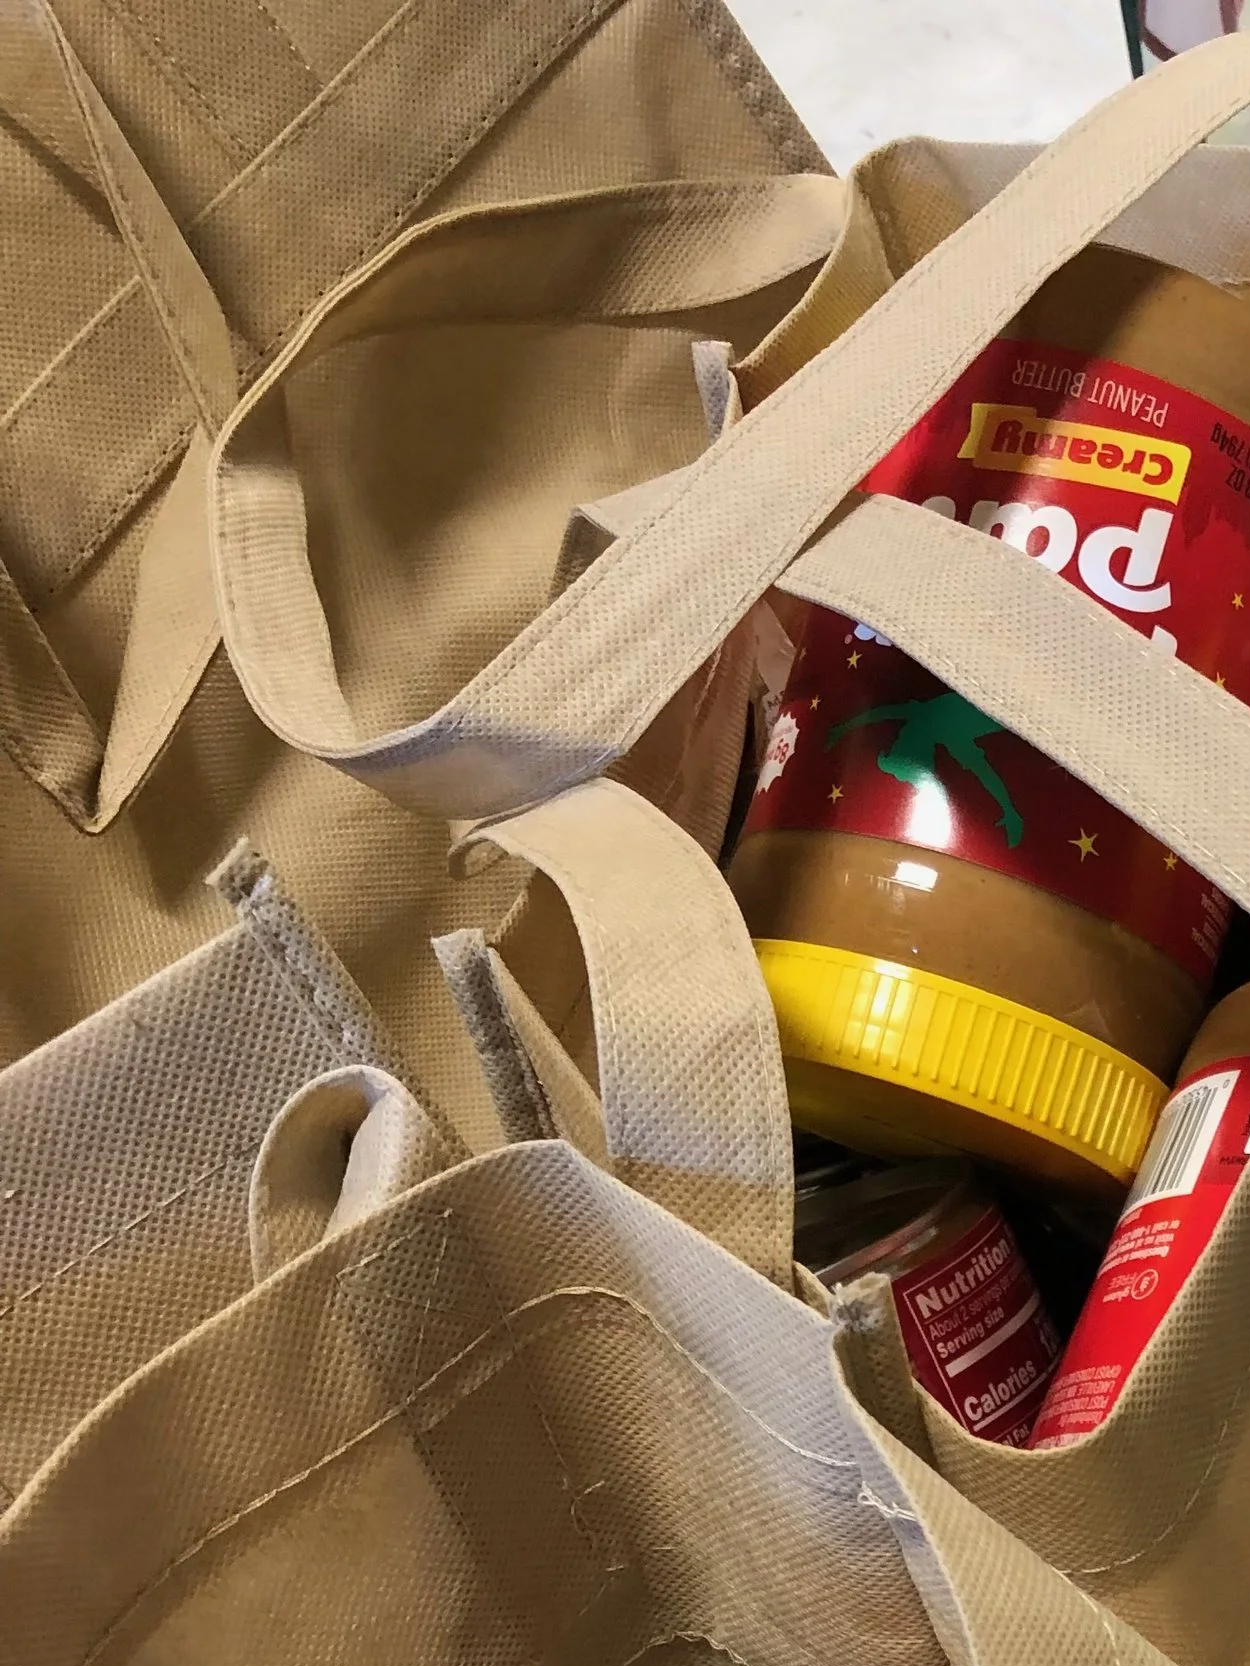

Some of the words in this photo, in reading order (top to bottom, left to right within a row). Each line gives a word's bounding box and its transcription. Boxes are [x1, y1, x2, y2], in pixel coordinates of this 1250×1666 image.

[1012, 360, 1086, 397] BUTTER
[1088, 378, 1168, 427] PEANUT
[991, 416, 1176, 488] Creamy
[916, 1240, 1008, 1317] Nutrition
[928, 1313, 961, 1340] About
[936, 1322, 985, 1358] Serving
[982, 1304, 1006, 1329] size
[964, 1361, 1036, 1420] Calories
